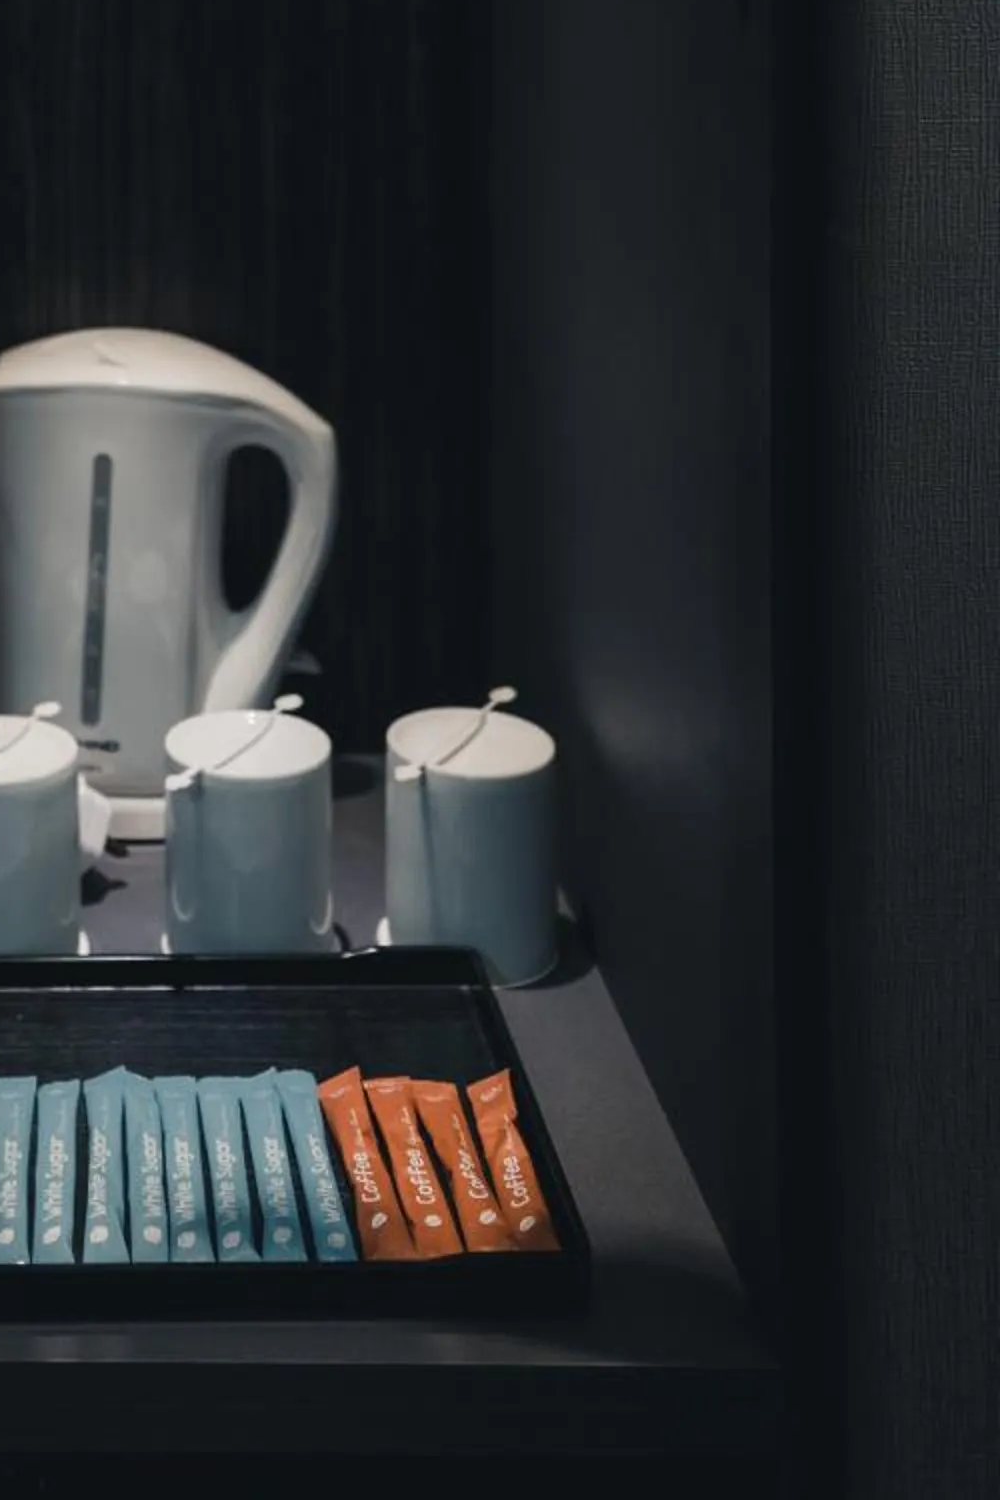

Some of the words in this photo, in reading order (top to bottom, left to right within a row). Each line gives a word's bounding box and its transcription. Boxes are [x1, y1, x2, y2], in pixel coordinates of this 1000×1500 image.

[45, 1133, 69, 1179] Sugar
[173, 1137, 195, 1179] Sugar
[215, 1137, 237, 1179] Sugar
[353, 1151, 381, 1203] Coffee
[407, 1148, 436, 1205] Coffee
[503, 1154, 530, 1208] Coffee
